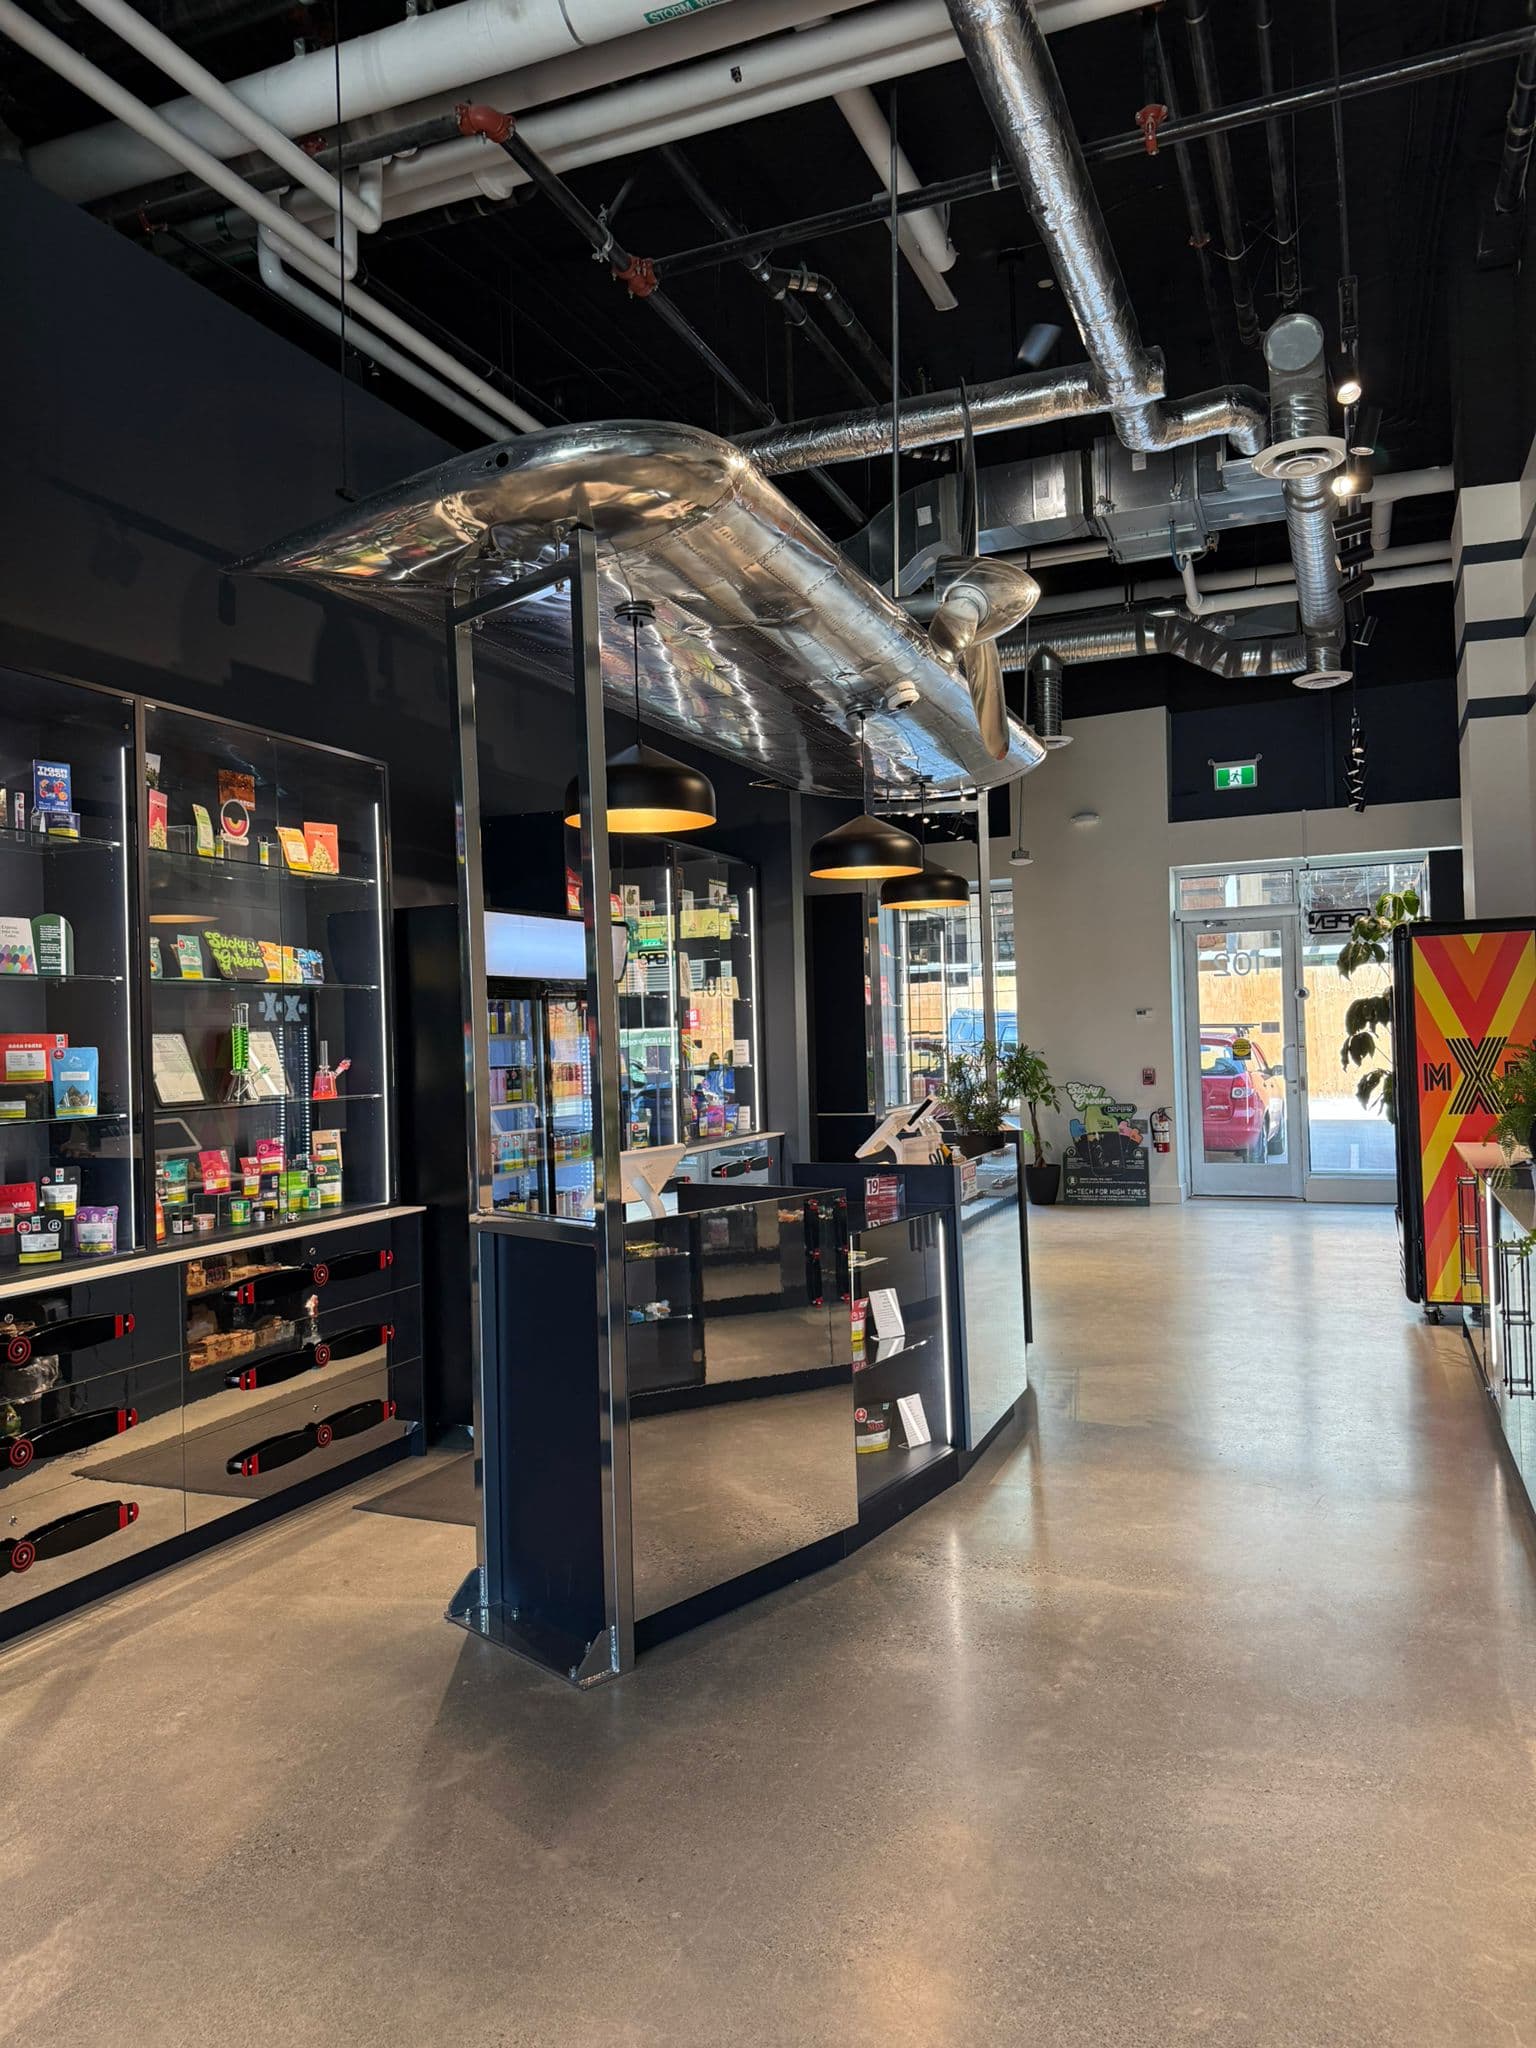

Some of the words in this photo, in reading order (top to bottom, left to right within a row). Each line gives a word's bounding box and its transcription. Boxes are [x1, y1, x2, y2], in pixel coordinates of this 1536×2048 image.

[648, 1, 694, 21] STORM
[204, 931, 248, 955] Sticky
[213, 948, 264, 973] Greens
[1067, 1083, 1101, 1097] Sticky
[1072, 1093, 1112, 1108] Greens
[868, 1180, 878, 1194] 19
[1127, 1188, 1146, 1196] TIMES
